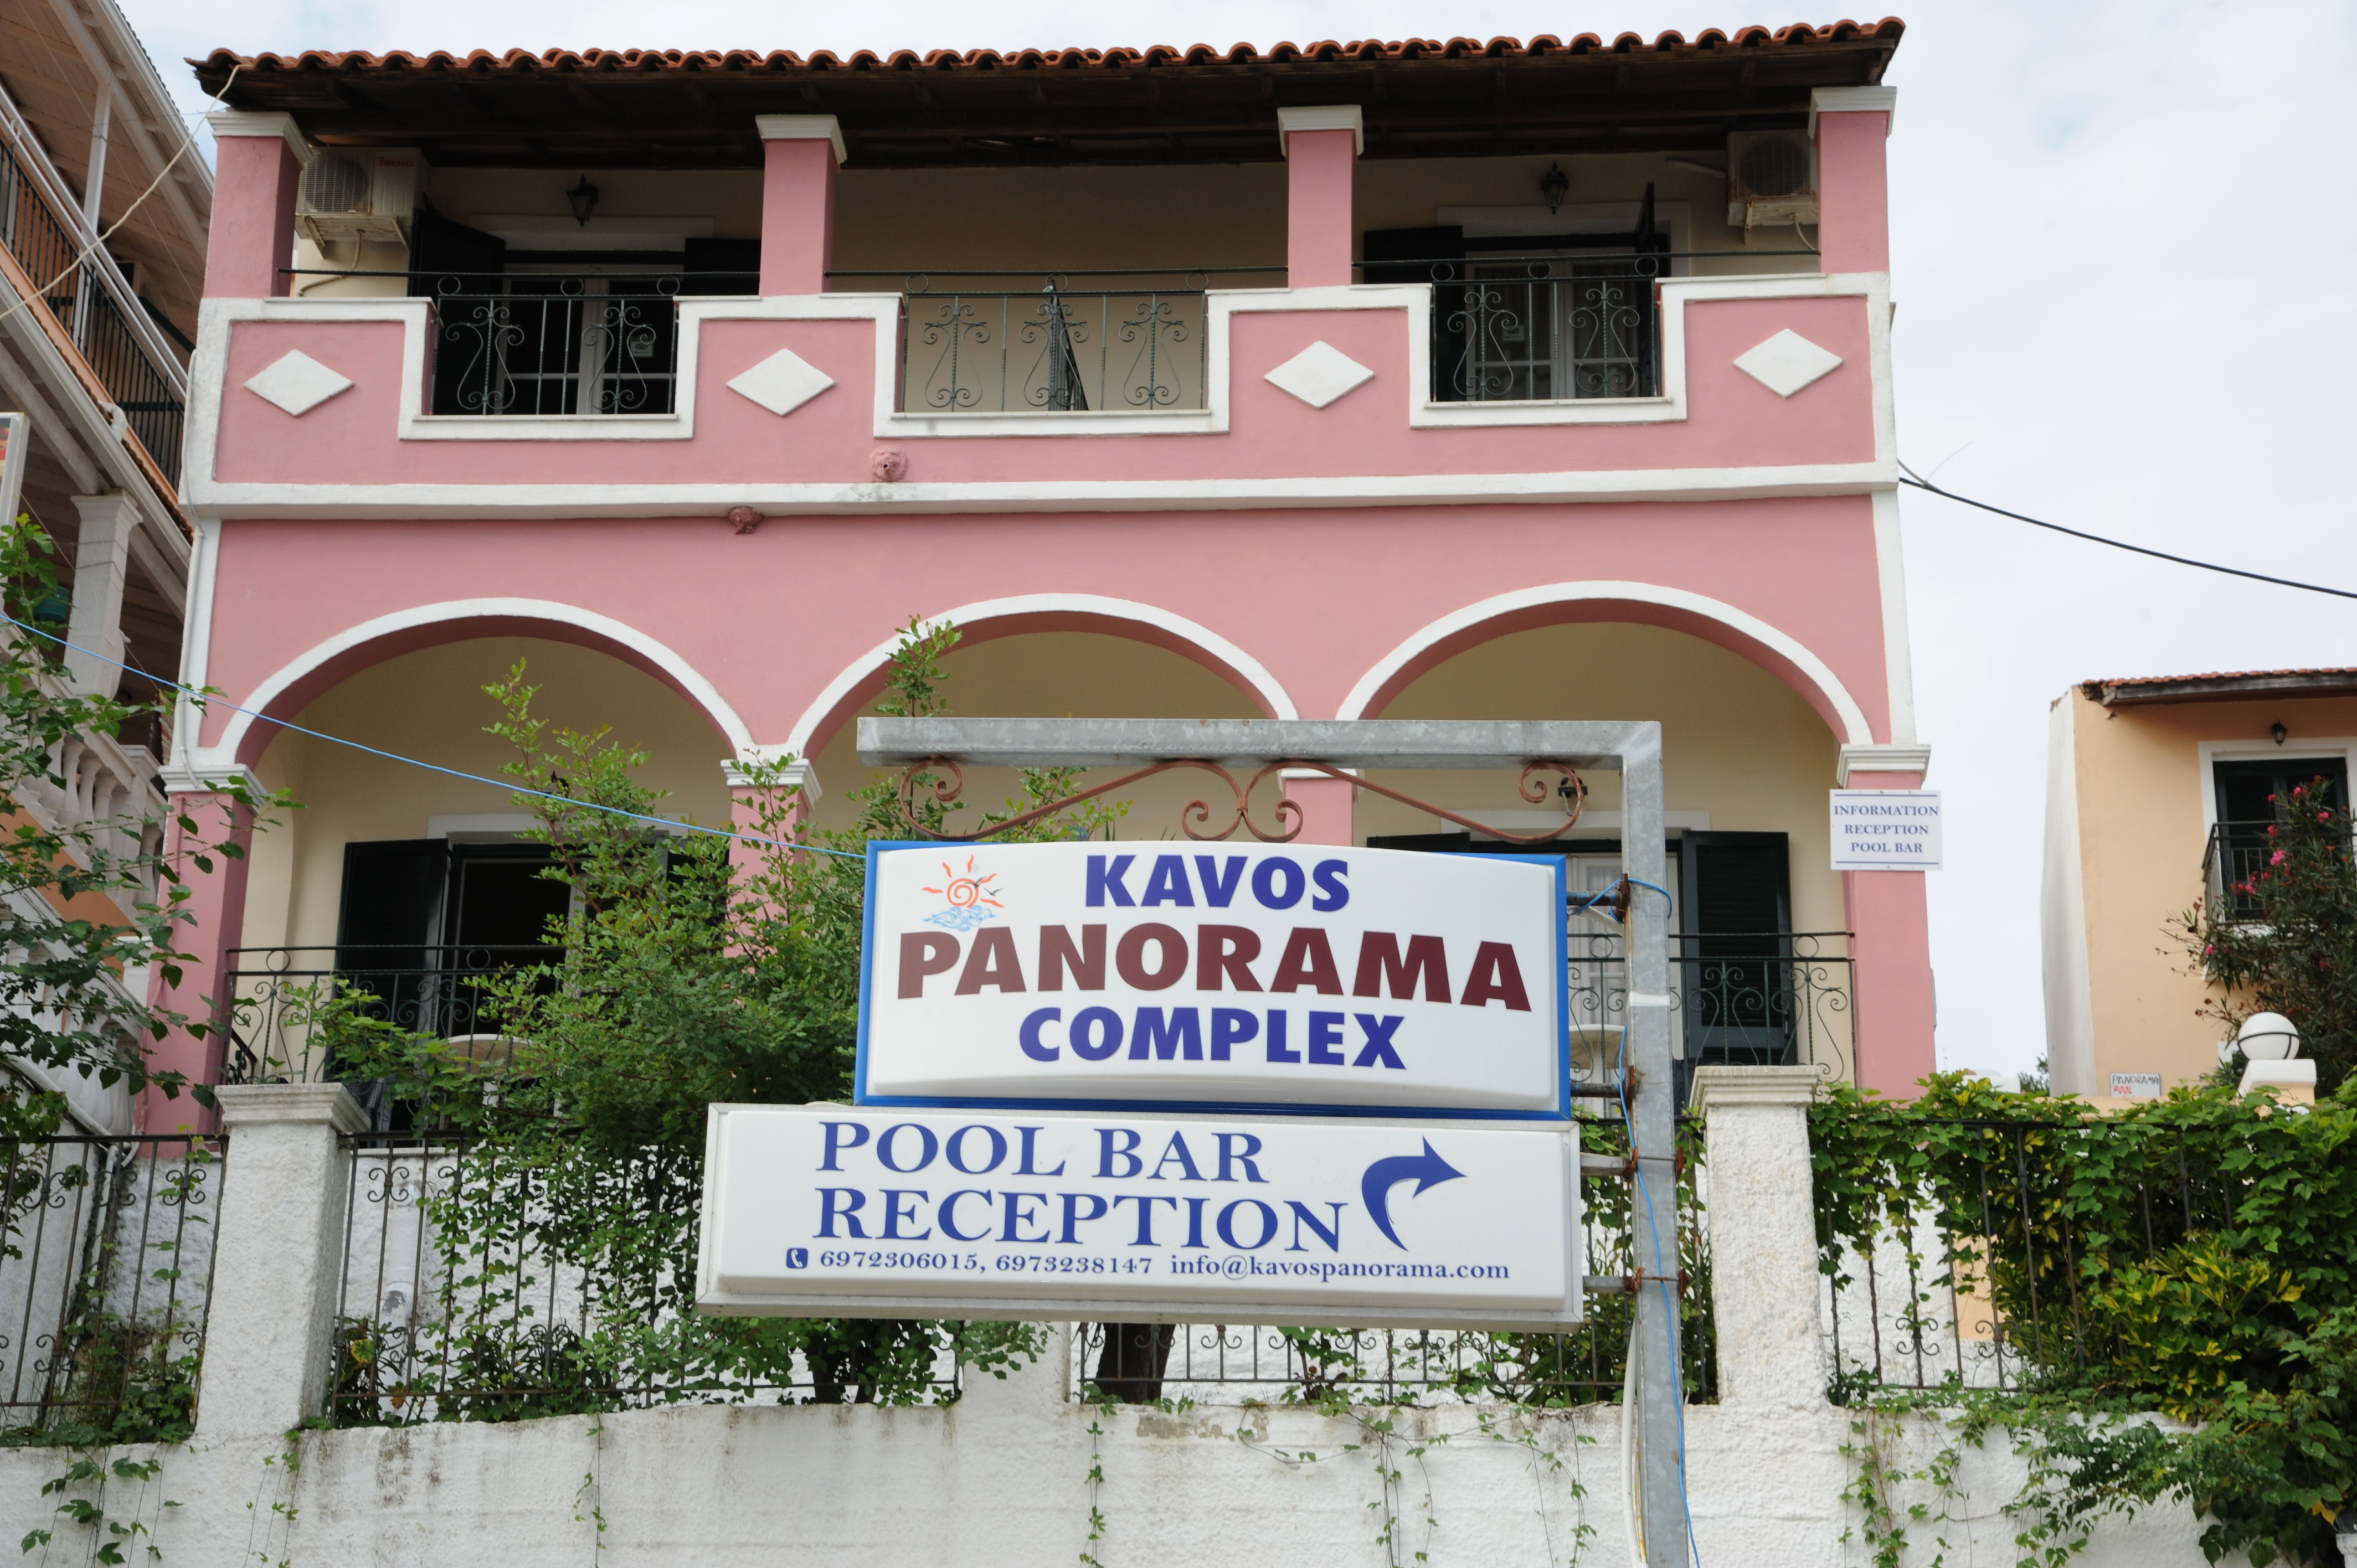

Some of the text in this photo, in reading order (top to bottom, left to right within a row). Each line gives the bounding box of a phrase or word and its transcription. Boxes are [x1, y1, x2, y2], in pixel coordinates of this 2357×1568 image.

[1834, 805, 1939, 816] INFORMATION
[1844, 824, 1929, 835] RECEPTION
[1851, 842, 1923, 853] POOL BAR
[1085, 855, 1350, 912] KAVOS
[898, 923, 1532, 1012] PANORAMA
[1019, 1006, 1407, 1070] COMPLEX
[2112, 1075, 2159, 1085] PANORAMA
[2113, 1086, 2132, 1094] POOL
[815, 1121, 1269, 1183] POOL BAR
[812, 1188, 1348, 1252] RECEPTION
[820, 1251, 1510, 1282] 6972306015, 6973238147 info@kavospanorama.com
